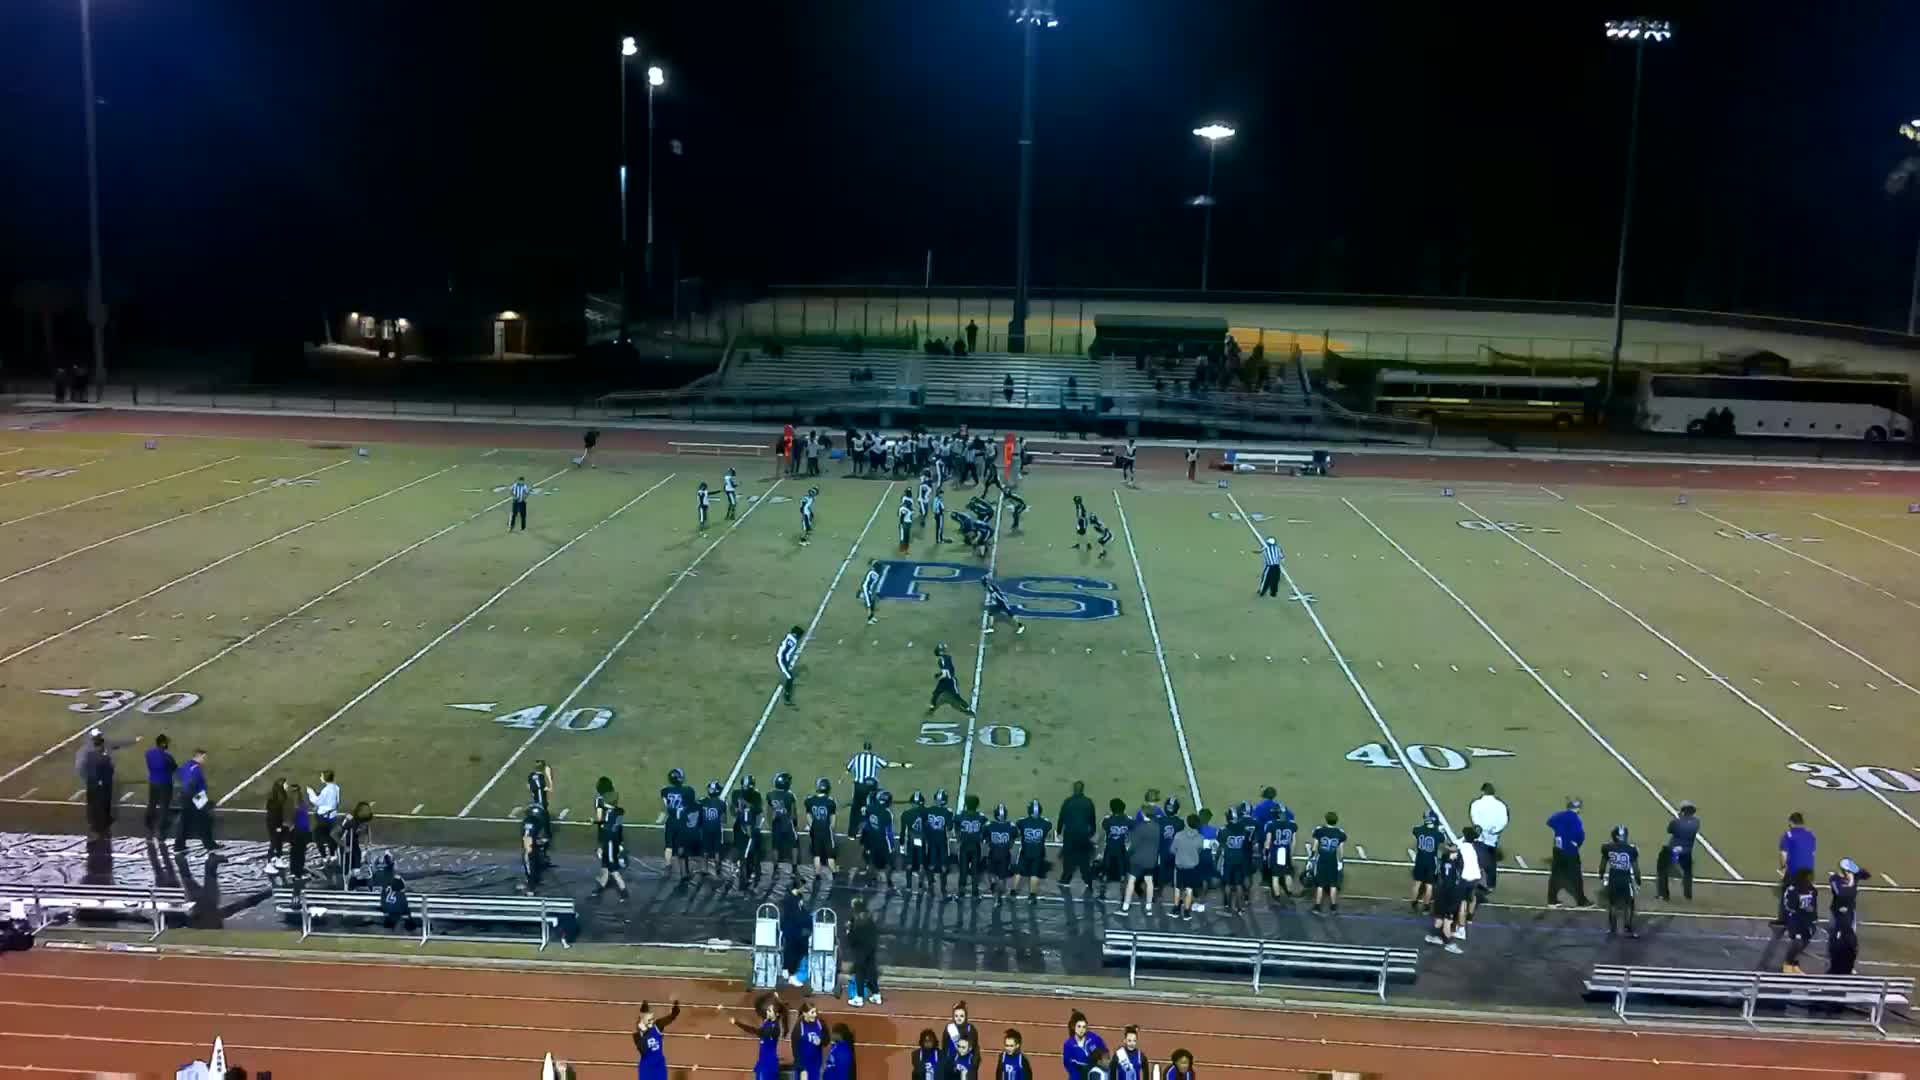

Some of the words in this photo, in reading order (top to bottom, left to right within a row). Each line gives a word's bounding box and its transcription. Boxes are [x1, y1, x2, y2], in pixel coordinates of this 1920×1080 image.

[68, 689, 200, 714] 30
[492, 704, 614, 731] 40
[915, 723, 1027, 748] 50
[1345, 743, 1468, 771] 40
[1786, 762, 1920, 792] 30
